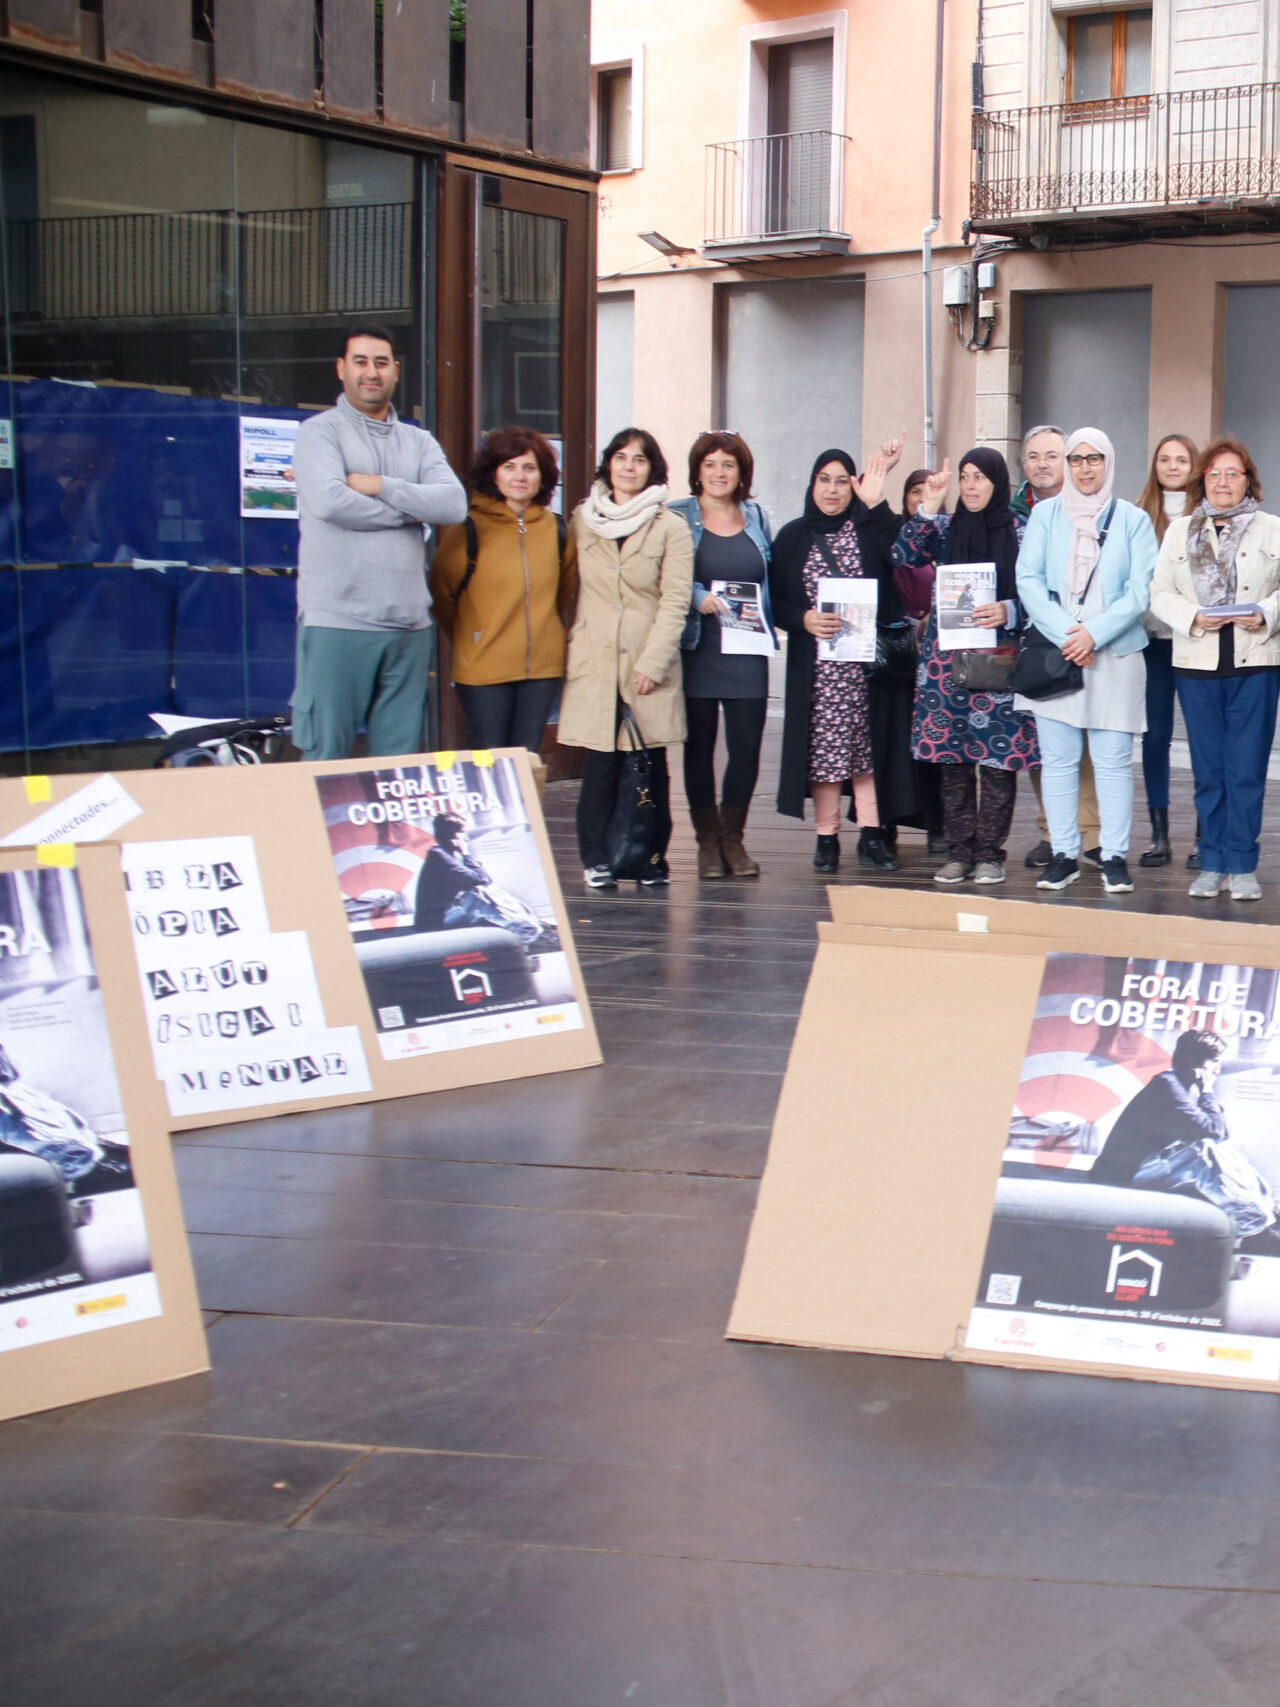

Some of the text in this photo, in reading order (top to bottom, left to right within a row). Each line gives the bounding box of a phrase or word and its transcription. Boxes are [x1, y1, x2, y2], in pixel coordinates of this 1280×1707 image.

[376, 775, 467, 800] FORA DE
[348, 792, 504, 826] COBERTURA
[183, 861, 244, 892] LA
[1121, 974, 1249, 1006] FORA DE
